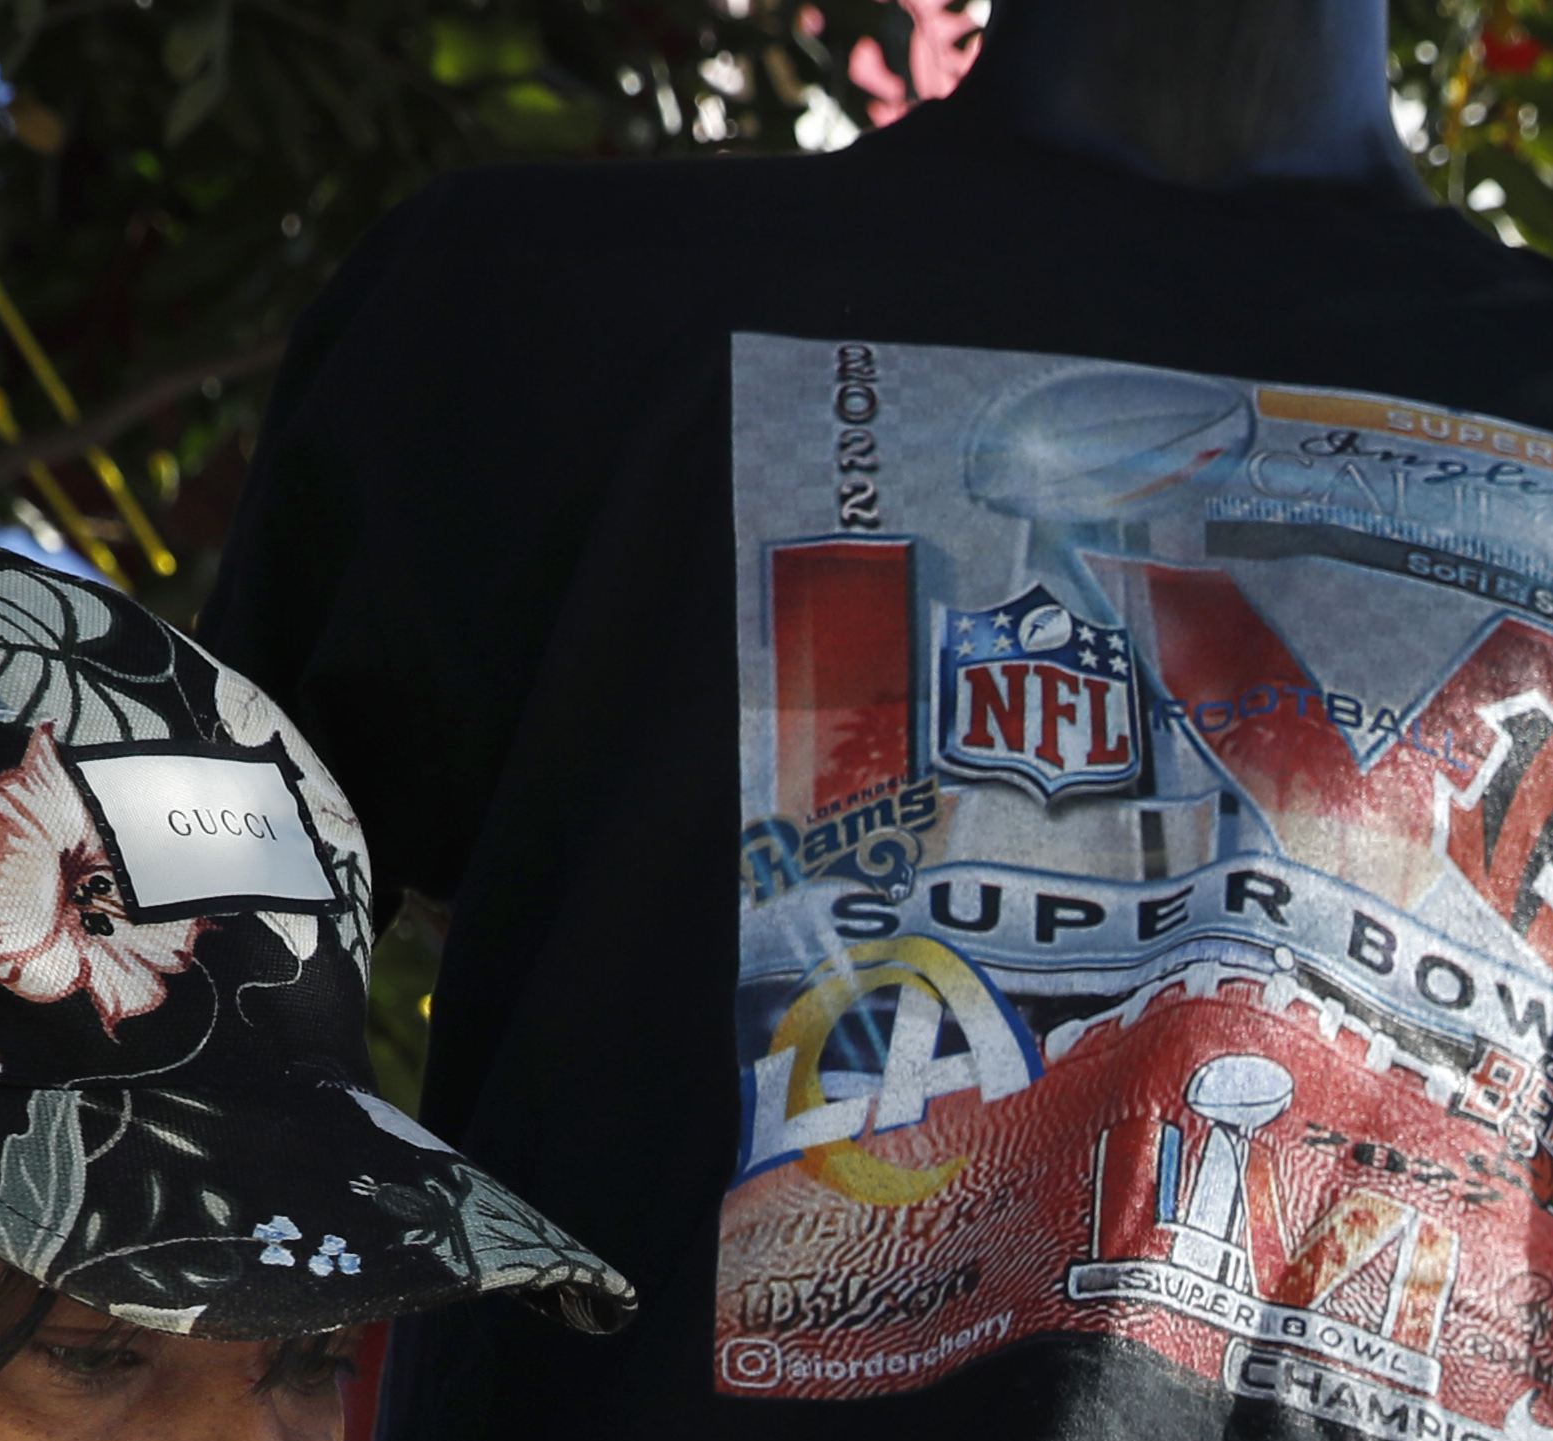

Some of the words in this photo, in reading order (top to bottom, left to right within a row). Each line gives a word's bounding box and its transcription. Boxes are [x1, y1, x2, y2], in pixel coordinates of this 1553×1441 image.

[835, 342, 880, 531] 2022
[1406, 551, 1490, 594] SoFi
[961, 662, 1129, 768] NFL
[1152, 683, 1469, 773] FOOTBALL
[167, 808, 278, 842] GUCCI
[739, 776, 940, 904] Rams
[806, 801, 842, 825] LOS
[831, 868, 1293, 943] SUPER
[733, 935, 1045, 1190] LA
[1119, 1266, 1255, 1329] SUPER
[1281, 1315, 1410, 1375] BOWL
